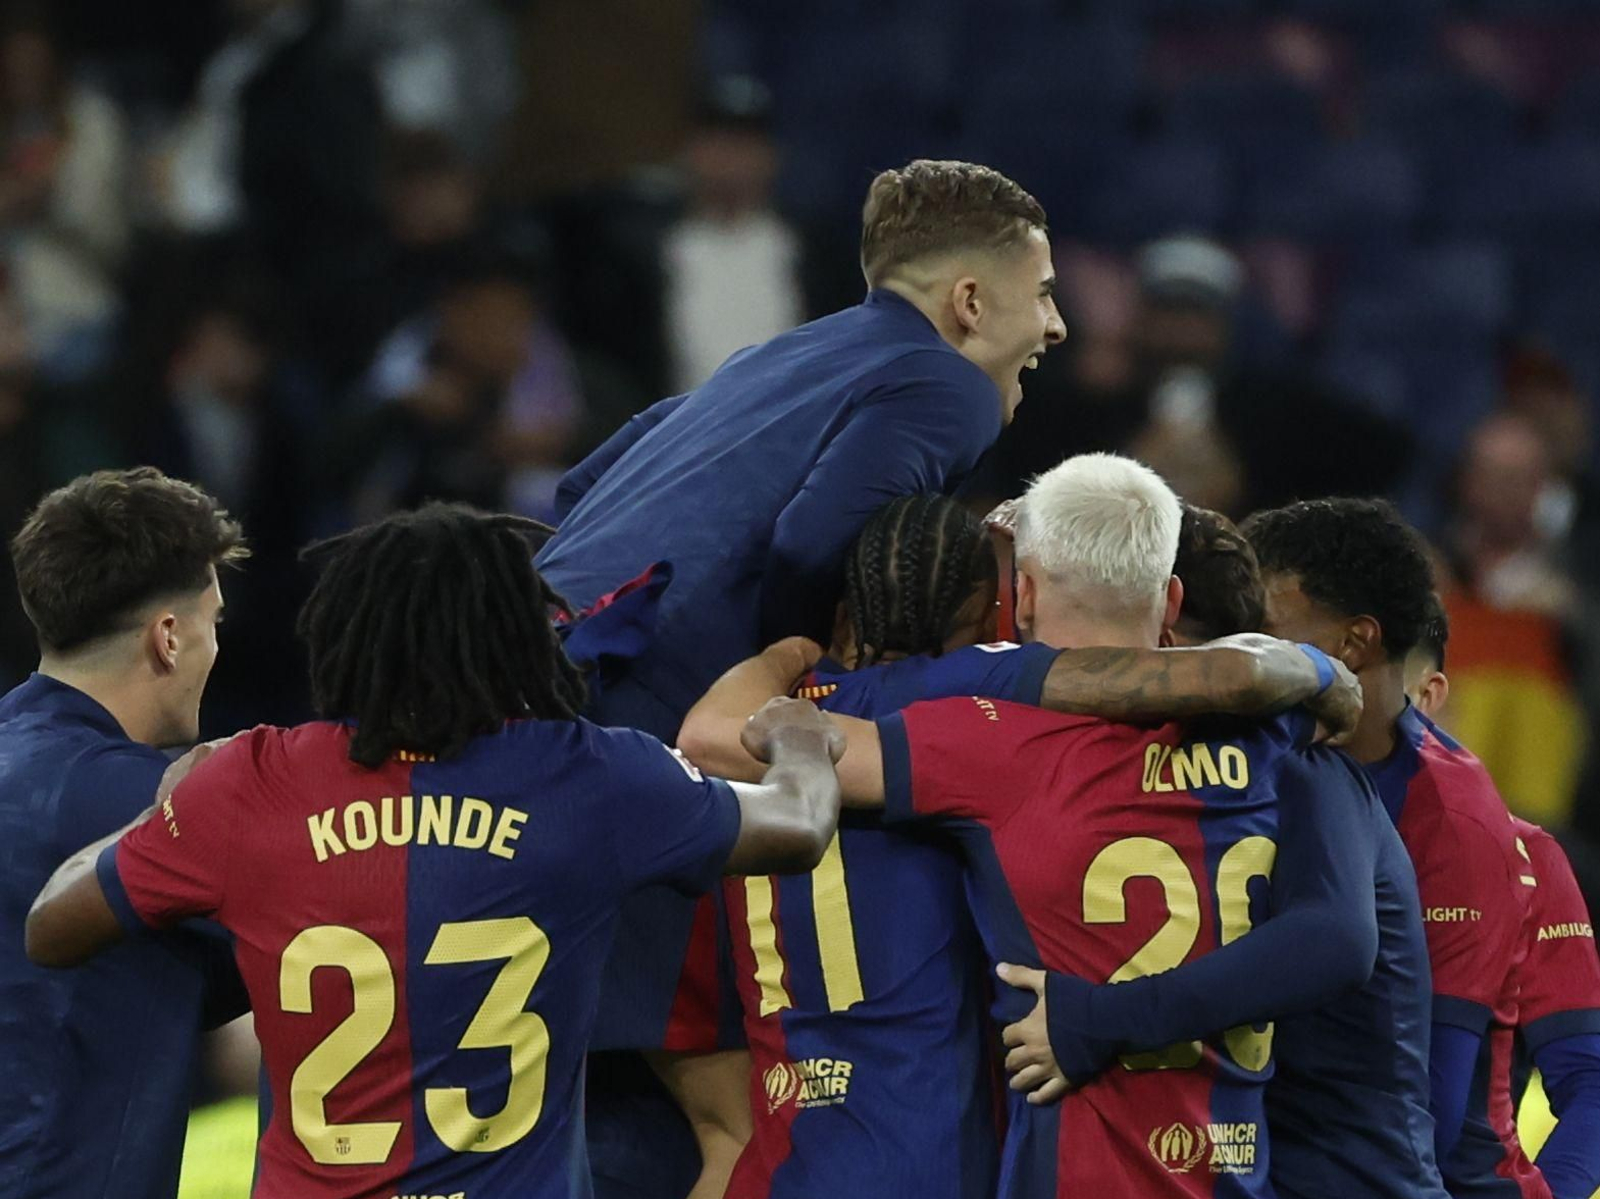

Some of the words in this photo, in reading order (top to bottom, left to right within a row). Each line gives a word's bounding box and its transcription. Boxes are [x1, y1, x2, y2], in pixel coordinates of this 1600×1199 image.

[1142, 742, 1249, 793] OLMO
[307, 795, 529, 863] KOUNDE
[279, 916, 551, 1164] 23
